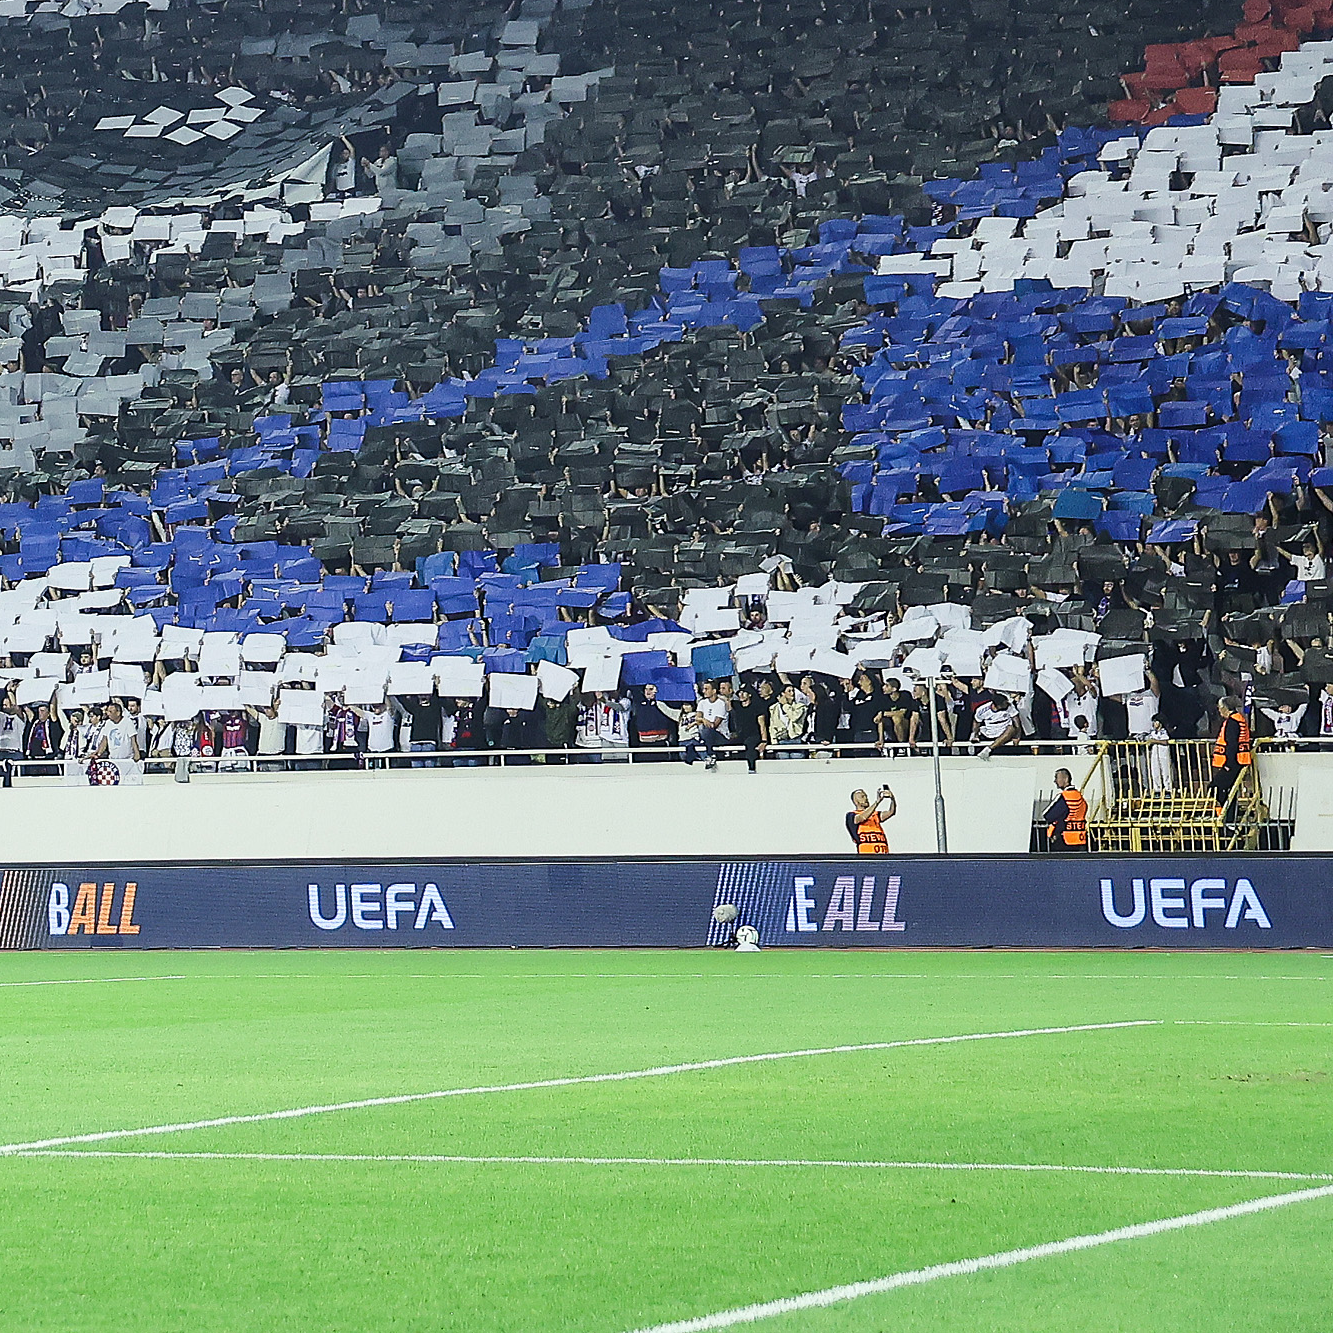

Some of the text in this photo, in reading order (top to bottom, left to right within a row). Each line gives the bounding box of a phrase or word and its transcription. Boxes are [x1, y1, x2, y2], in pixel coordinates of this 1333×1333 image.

[48, 882, 141, 936] BALL
[308, 883, 455, 930] UEFA
[821, 875, 906, 932] ALL
[1099, 878, 1272, 930] UEFA
